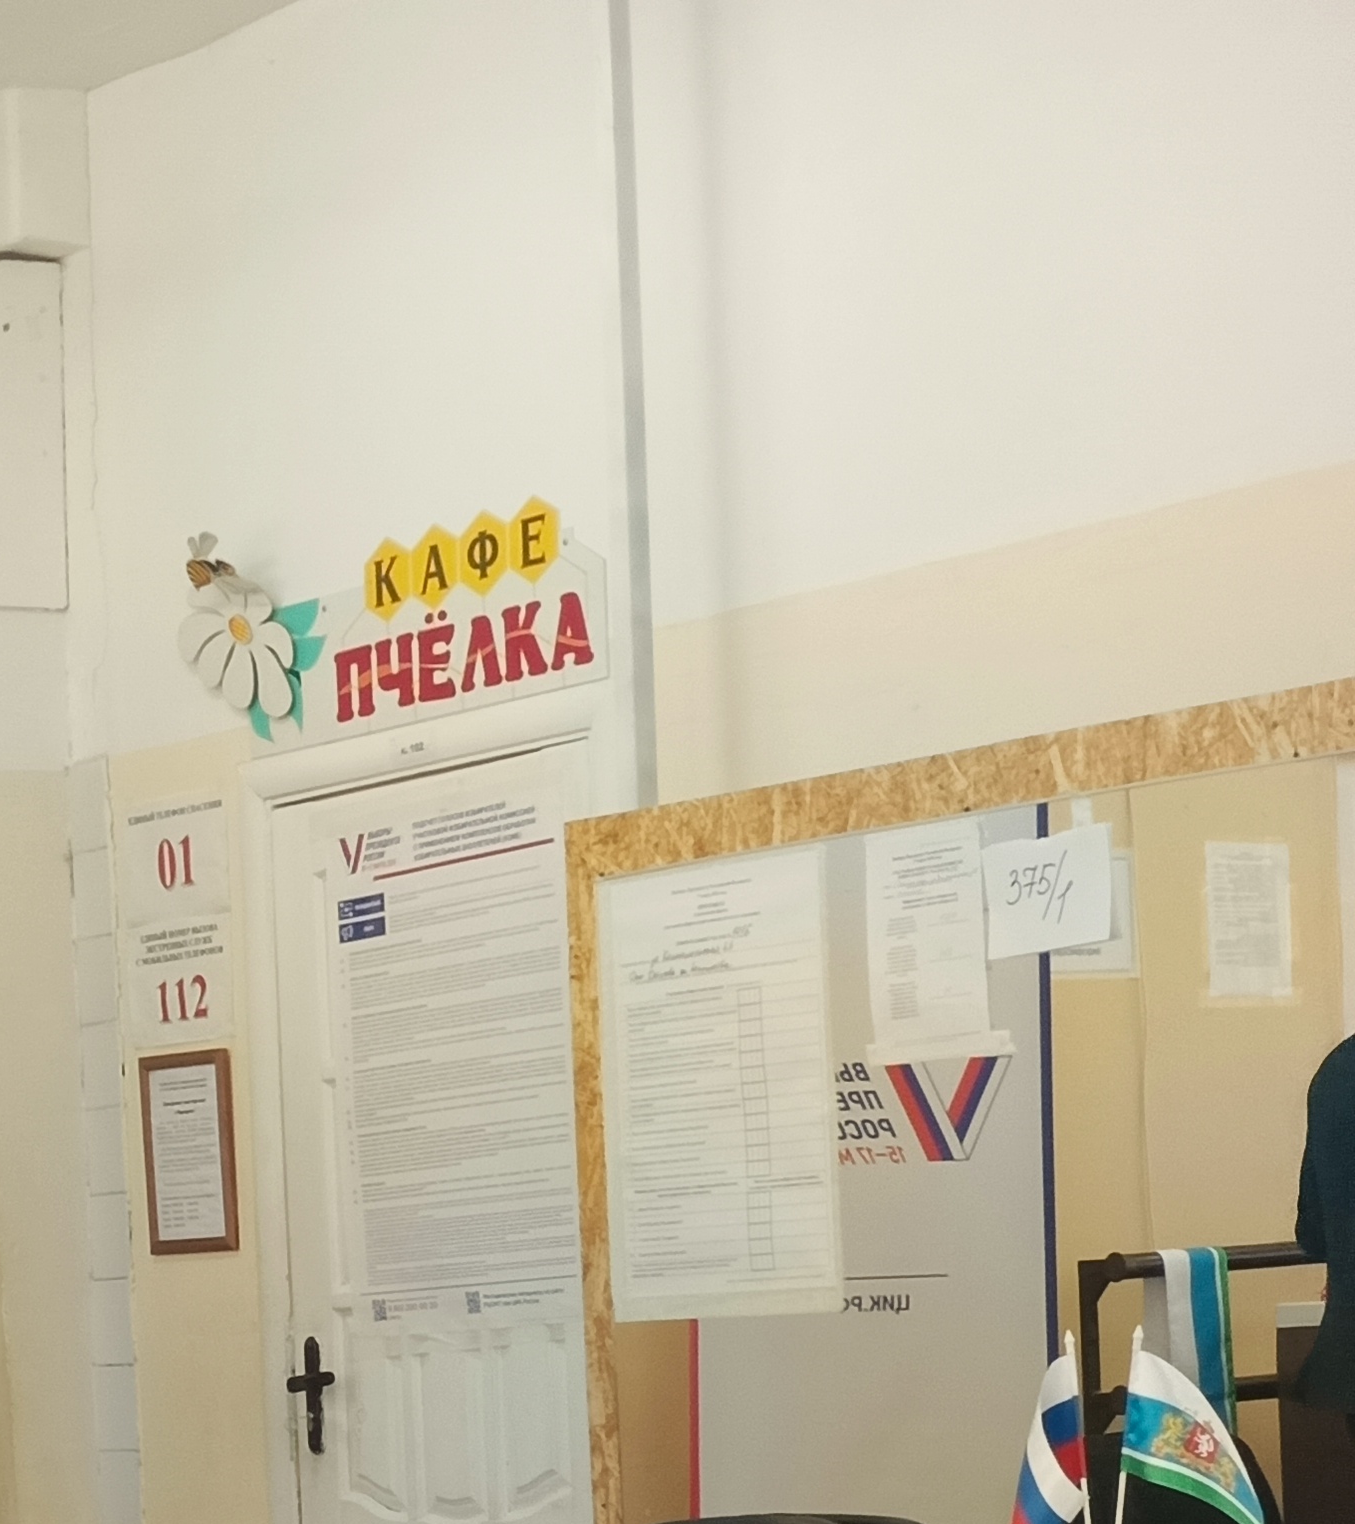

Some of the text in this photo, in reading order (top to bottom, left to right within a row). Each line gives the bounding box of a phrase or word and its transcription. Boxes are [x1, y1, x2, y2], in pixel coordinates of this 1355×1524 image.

[373, 513, 547, 608] КАФЕ
[333, 592, 594, 723] ПЧЁЛКА
[158, 834, 194, 890] 01
[1005, 849, 1074, 925] 375/1
[157, 974, 209, 1023] 112
